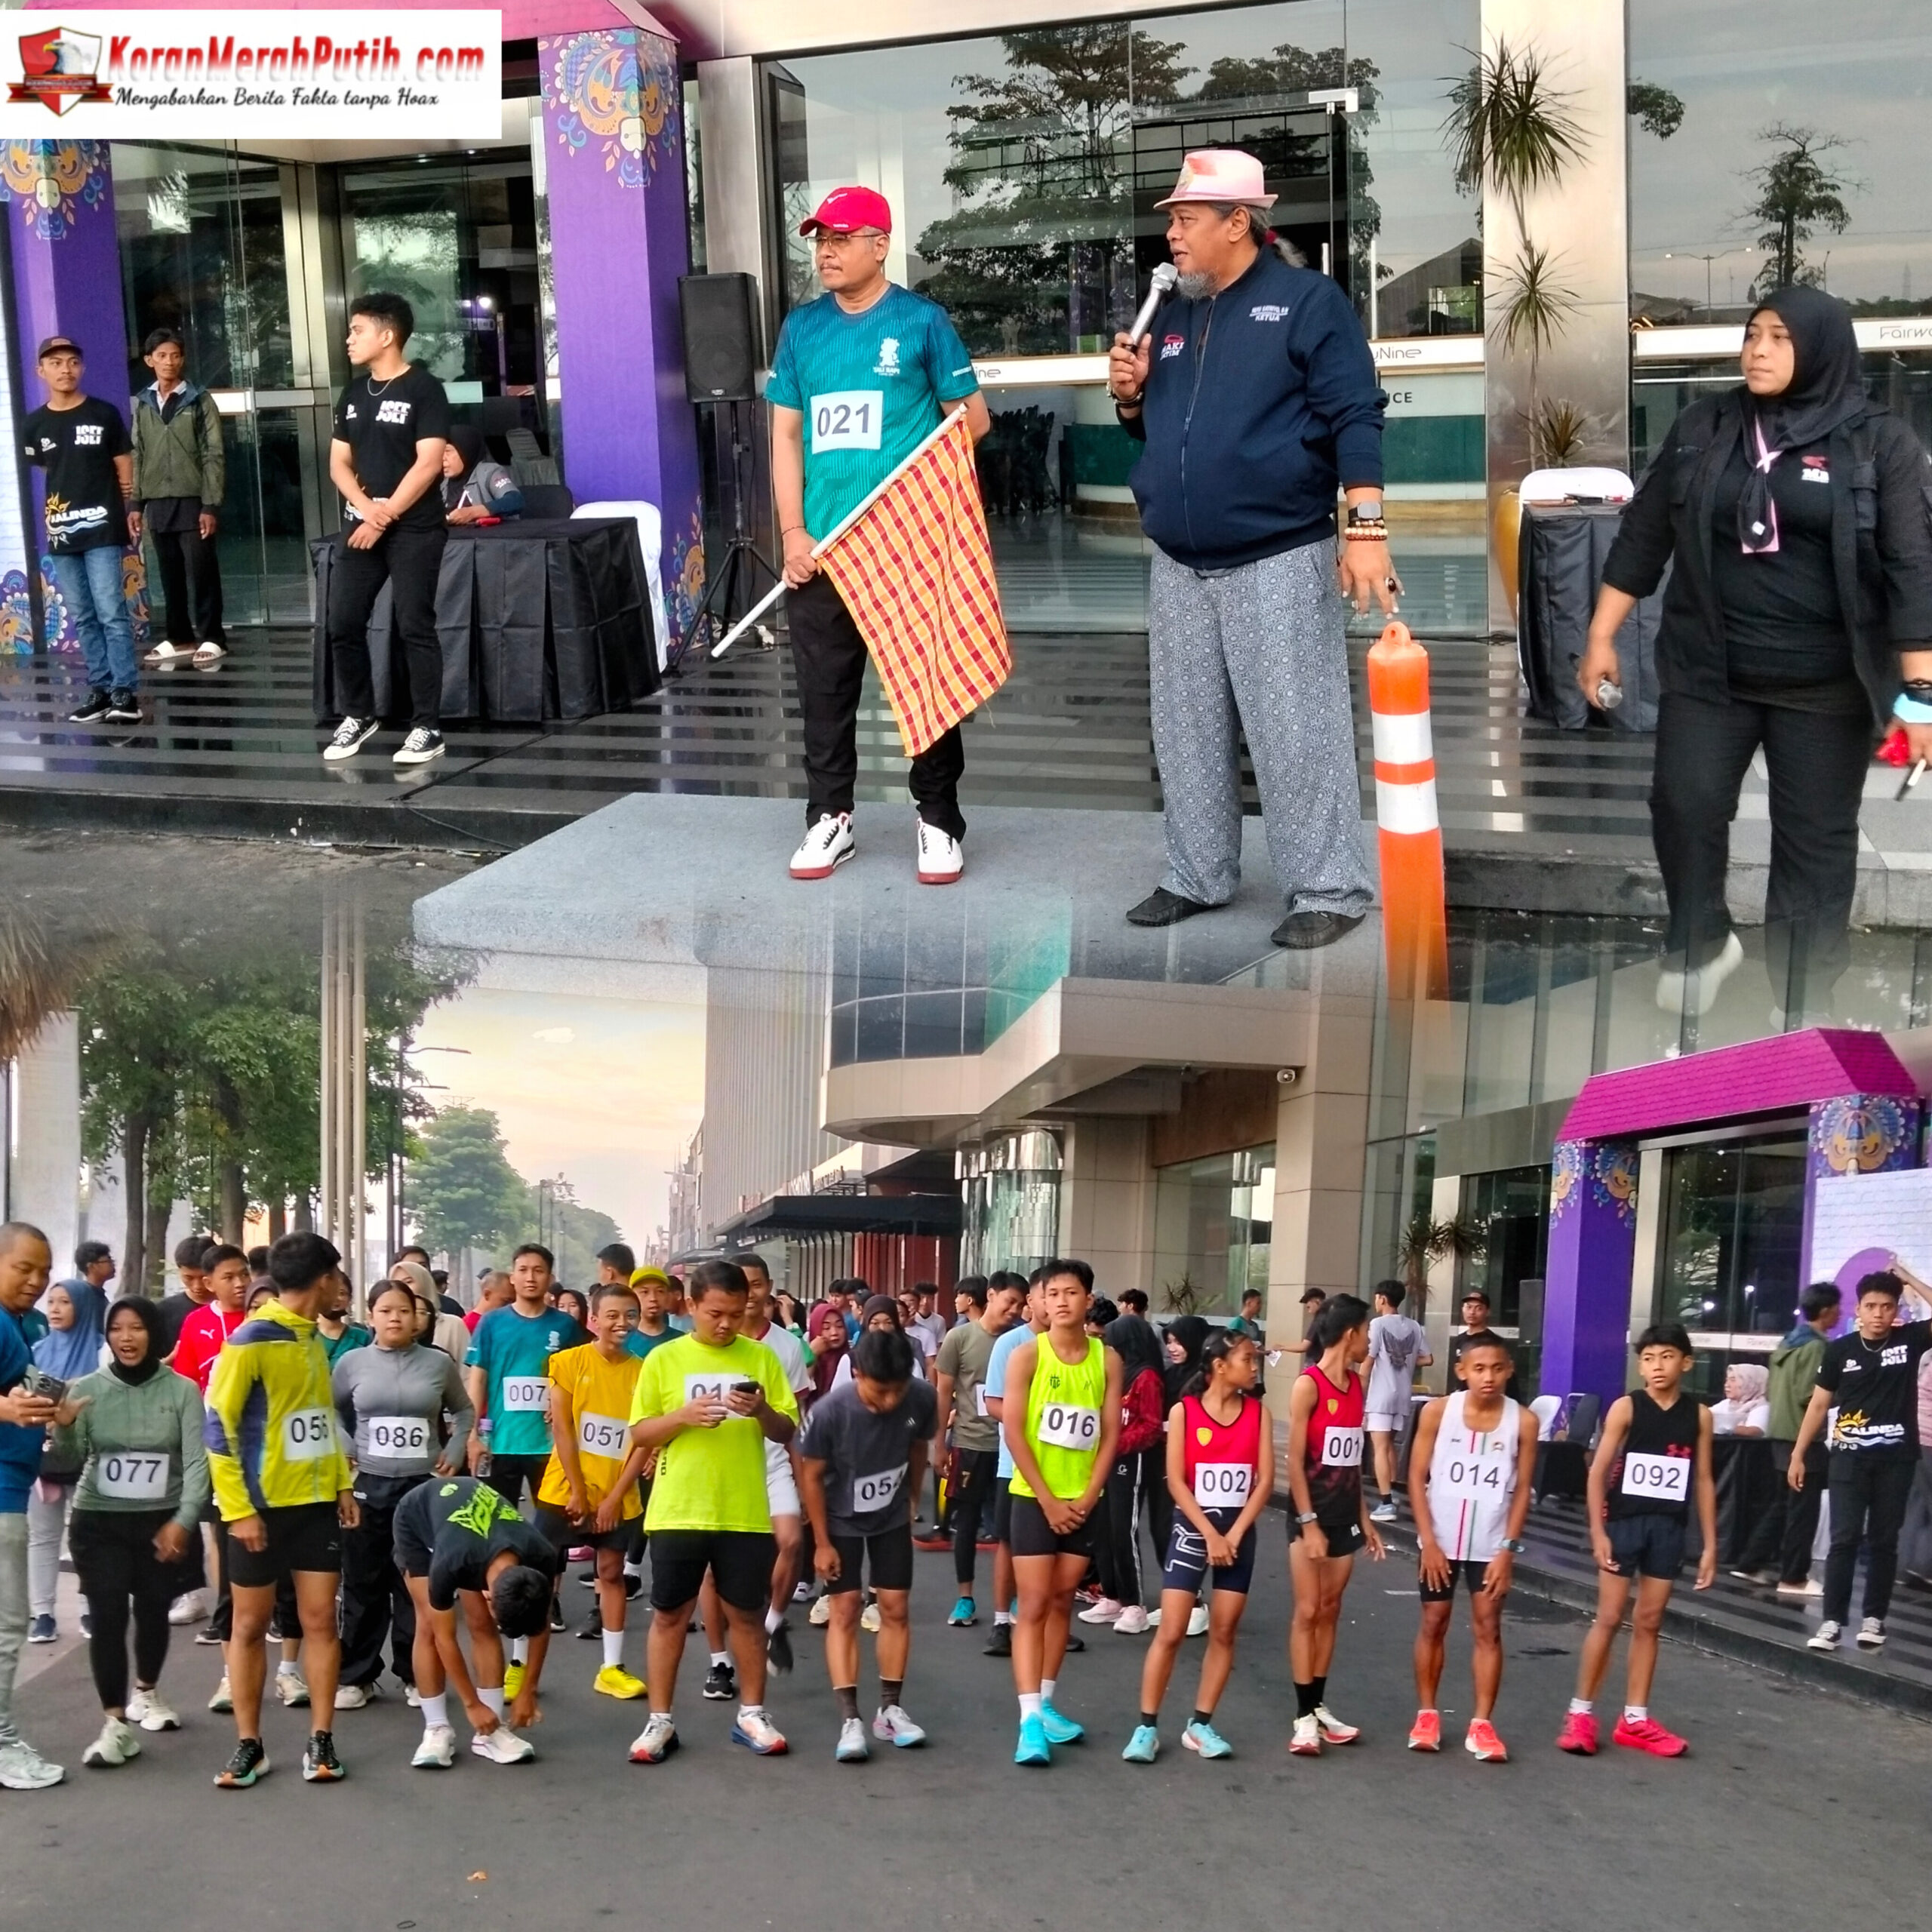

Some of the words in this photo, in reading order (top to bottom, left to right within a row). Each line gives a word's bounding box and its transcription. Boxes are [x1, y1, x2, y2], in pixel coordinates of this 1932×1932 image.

[1879, 325, 1932, 340] Fairw
[1387, 392, 1413, 404] CE
[817, 403, 869, 438] 021
[509, 1384, 546, 1402] 007
[691, 1383, 737, 1401] 01
[1048, 1407, 1095, 1438] 016
[376, 1426, 423, 1448] 086
[583, 1422, 626, 1450] 051
[1329, 1436, 1359, 1459] 001
[106, 1458, 162, 1483] 077
[1202, 1469, 1246, 1493] 002
[1450, 1461, 1500, 1489] 014
[1632, 1463, 1680, 1490] 092
